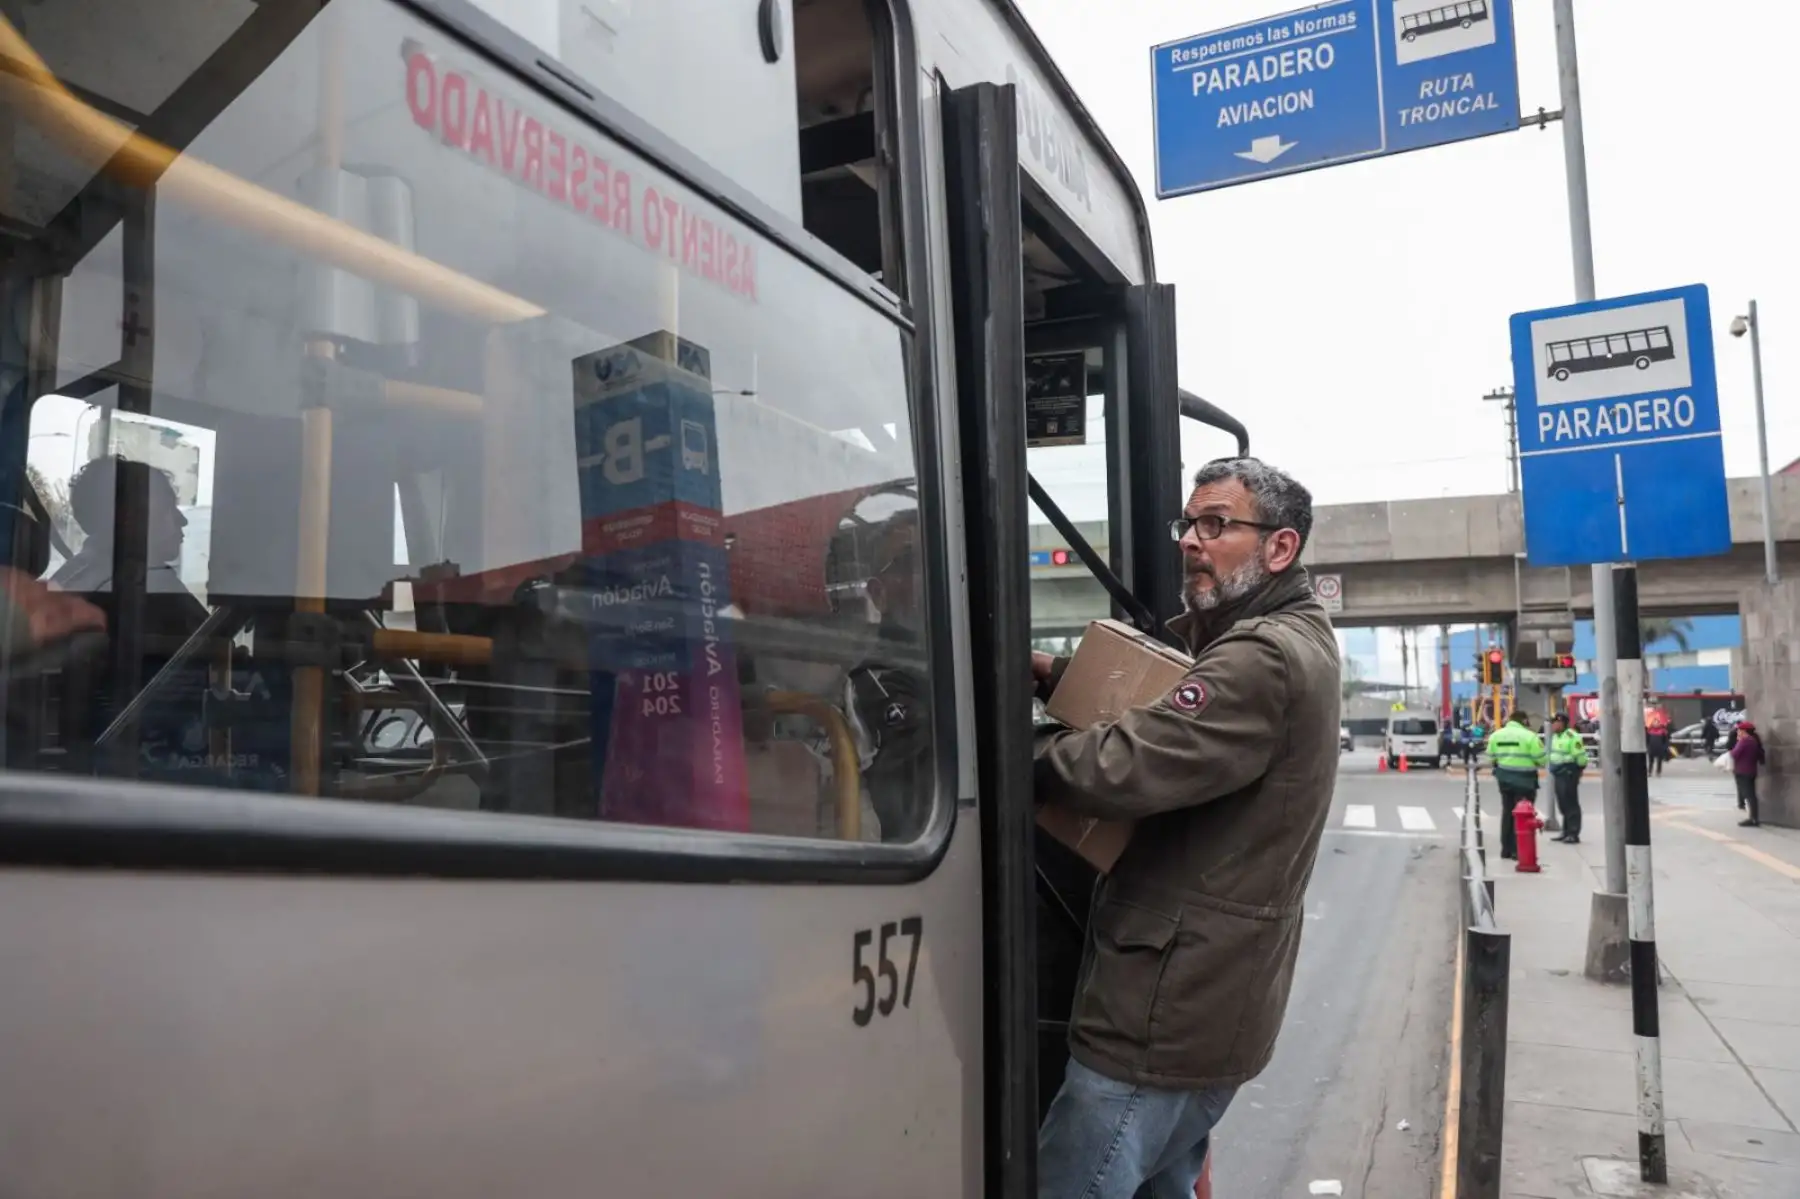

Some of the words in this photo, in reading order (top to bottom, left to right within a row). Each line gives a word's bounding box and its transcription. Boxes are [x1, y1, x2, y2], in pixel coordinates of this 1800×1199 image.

[1172, 32, 1264, 63] Respetemos
[1267, 23, 1290, 42] las
[1294, 11, 1357, 36] Normas
[1192, 43, 1335, 96] PARADERO
[1419, 72, 1475, 100] RUTA
[1217, 89, 1315, 128] AVIACION
[1398, 91, 1499, 127] TRONCAL
[1538, 395, 1695, 443] PARADERO
[852, 916, 923, 1028] 557
